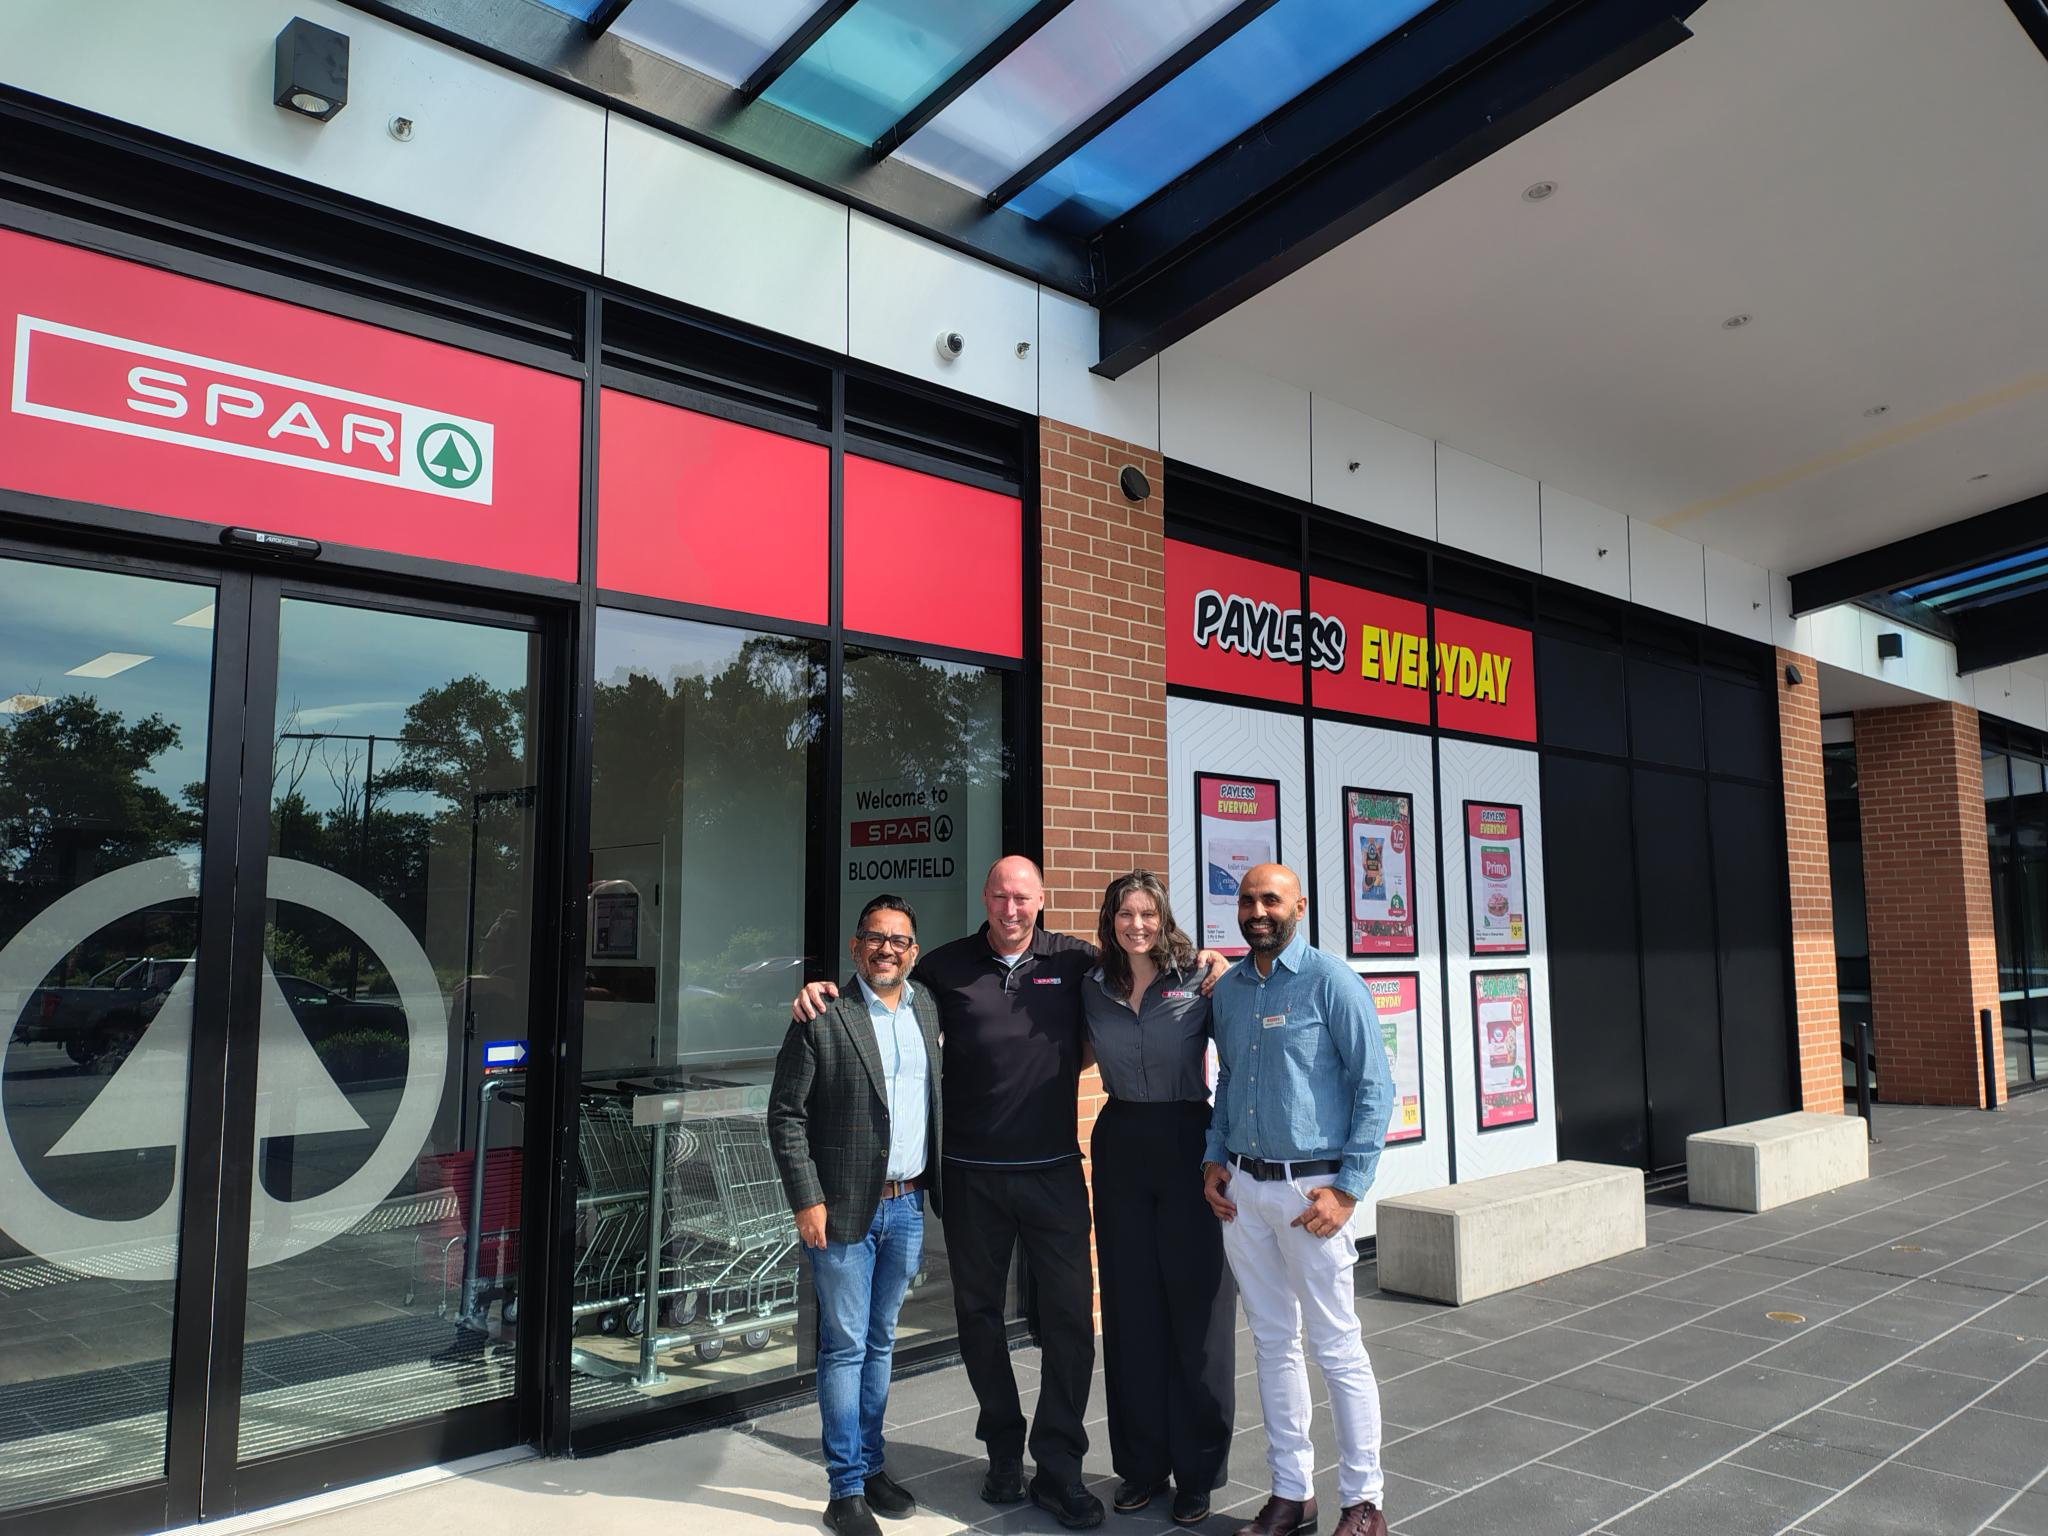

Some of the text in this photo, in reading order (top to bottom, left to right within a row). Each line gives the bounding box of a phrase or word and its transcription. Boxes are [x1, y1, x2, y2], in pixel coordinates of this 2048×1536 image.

[127, 366, 395, 462] SPAR
[1194, 589, 1512, 706] PAYLESS EVERYDAY
[856, 786, 948, 810] Welcome to
[1220, 783, 1256, 800] PAYLESS
[1217, 800, 1258, 815] EVERYDAY
[1481, 810, 1506, 823] PAYLESS
[868, 821, 929, 841] SPAR
[1392, 829, 1404, 842] 1/2
[1480, 823, 1507, 835] EVERYDAY
[848, 857, 955, 881] BLOOMFIELD
[1486, 861, 1508, 876] Primo
[1370, 981, 1400, 995] PAYLESS
[1373, 995, 1402, 1009] ERYDAY
